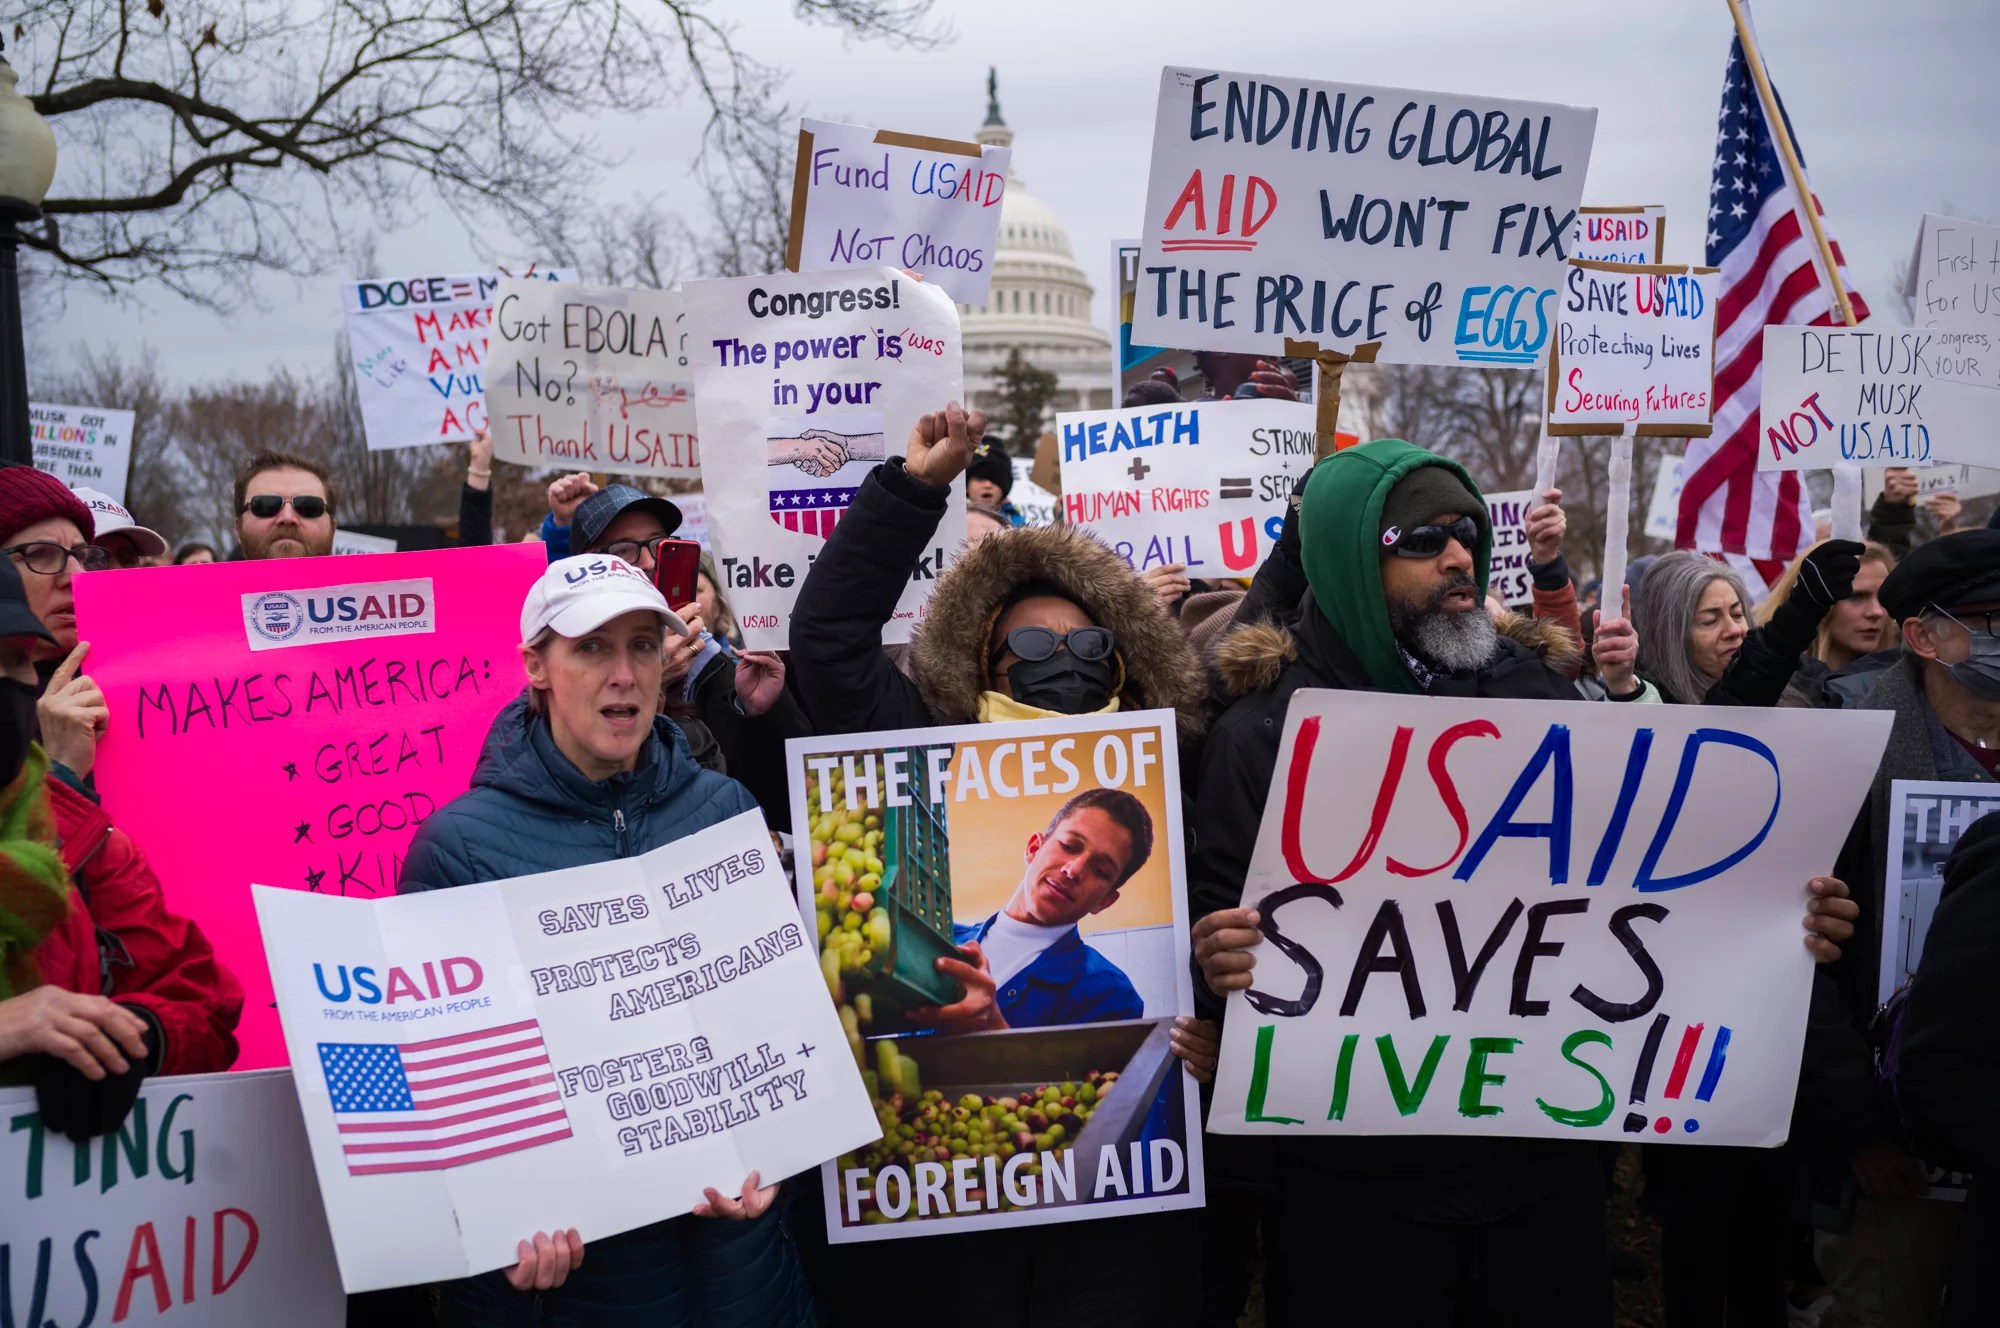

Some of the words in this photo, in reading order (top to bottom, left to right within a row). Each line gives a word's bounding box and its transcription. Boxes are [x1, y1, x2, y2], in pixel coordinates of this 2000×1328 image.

[1189, 74, 1374, 154] ENDING
[1389, 101, 1562, 181] GLOBAL
[813, 148, 889, 191] Fund
[912, 160, 1004, 207] USAID
[1164, 168, 1277, 238] AID
[1320, 189, 1469, 251] WON'T
[1492, 203, 1576, 262] FIX
[1588, 218, 1648, 242] USAID
[902, 233, 983, 272] Chaos
[1937, 228, 1978, 277] First
[748, 280, 900, 319] Congress!
[1145, 266, 1240, 330] THE
[1254, 274, 1394, 341] PRICE
[1405, 281, 1443, 342] of
[1455, 284, 1557, 353] EGGS
[1567, 268, 1628, 316] SAVE
[1636, 274, 1704, 320] USAID
[1926, 279, 1959, 314] for
[499, 294, 550, 345] Got
[909, 331, 945, 356] was
[713, 338, 766, 367] The
[774, 334, 866, 369] power
[1560, 322, 1653, 370] Protecting
[1661, 334, 1700, 359] Lives
[1935, 355, 1982, 377] YOUR
[429, 373, 484, 399] VUL
[516, 357, 578, 405] No?
[773, 378, 797, 405] in
[806, 380, 882, 414] your
[1565, 367, 1640, 421] Securing
[1646, 384, 1706, 412] Futures
[1857, 383, 1922, 420] MUSK
[80, 413, 105, 429] GOT
[507, 414, 599, 461] Thank
[609, 423, 700, 468] USAID
[1063, 409, 1200, 462] HEALTH
[1767, 391, 1834, 461] NOT
[32, 442, 94, 461] UBSIDIES
[67, 462, 103, 479] THAN
[84, 500, 129, 518] USAID
[1065, 488, 1141, 525] HUMAN
[1152, 486, 1211, 513] RIGHTS
[564, 560, 654, 586] USAD
[722, 556, 795, 588] Take
[307, 593, 426, 623] USAID
[309, 627, 334, 635] FROM
[335, 624, 352, 633] THE
[353, 622, 397, 632] AMERICAN
[398, 620, 428, 629] PEOPLE
[743, 615, 780, 628] USAID.
[891, 608, 914, 620] Save
[137, 673, 293, 738] MAKES
[306, 655, 492, 715] AMERICA:
[314, 725, 445, 783] GREAT
[808, 751, 912, 813] THE
[928, 735, 1080, 804] FACES
[1093, 732, 1157, 790] OF
[327, 792, 435, 840] GOOD
[1281, 715, 1781, 892] USAID
[539, 894, 650, 936] SAVES
[663, 849, 765, 910] LIVES
[531, 932, 701, 997] PROTECTS
[609, 923, 803, 1021] AMERICANS
[1245, 883, 1670, 1023] SAVES
[313, 955, 484, 1005] USAID
[323, 1008, 354, 1020] FROM
[358, 1010, 378, 1021] THE
[380, 1006, 443, 1022] AMERICAN
[446, 996, 492, 1014] PEOPLE
[559, 1035, 713, 1097] FOSTERS
[606, 1042, 785, 1121] GOODWILL
[1245, 1012, 1732, 1135] LIVES!!!
[618, 1069, 808, 1157] STABILITY
[845, 1148, 1077, 1223] FOREIGN
[1094, 1138, 1185, 1201] AID
[0, 1208, 259, 1328] USAID
